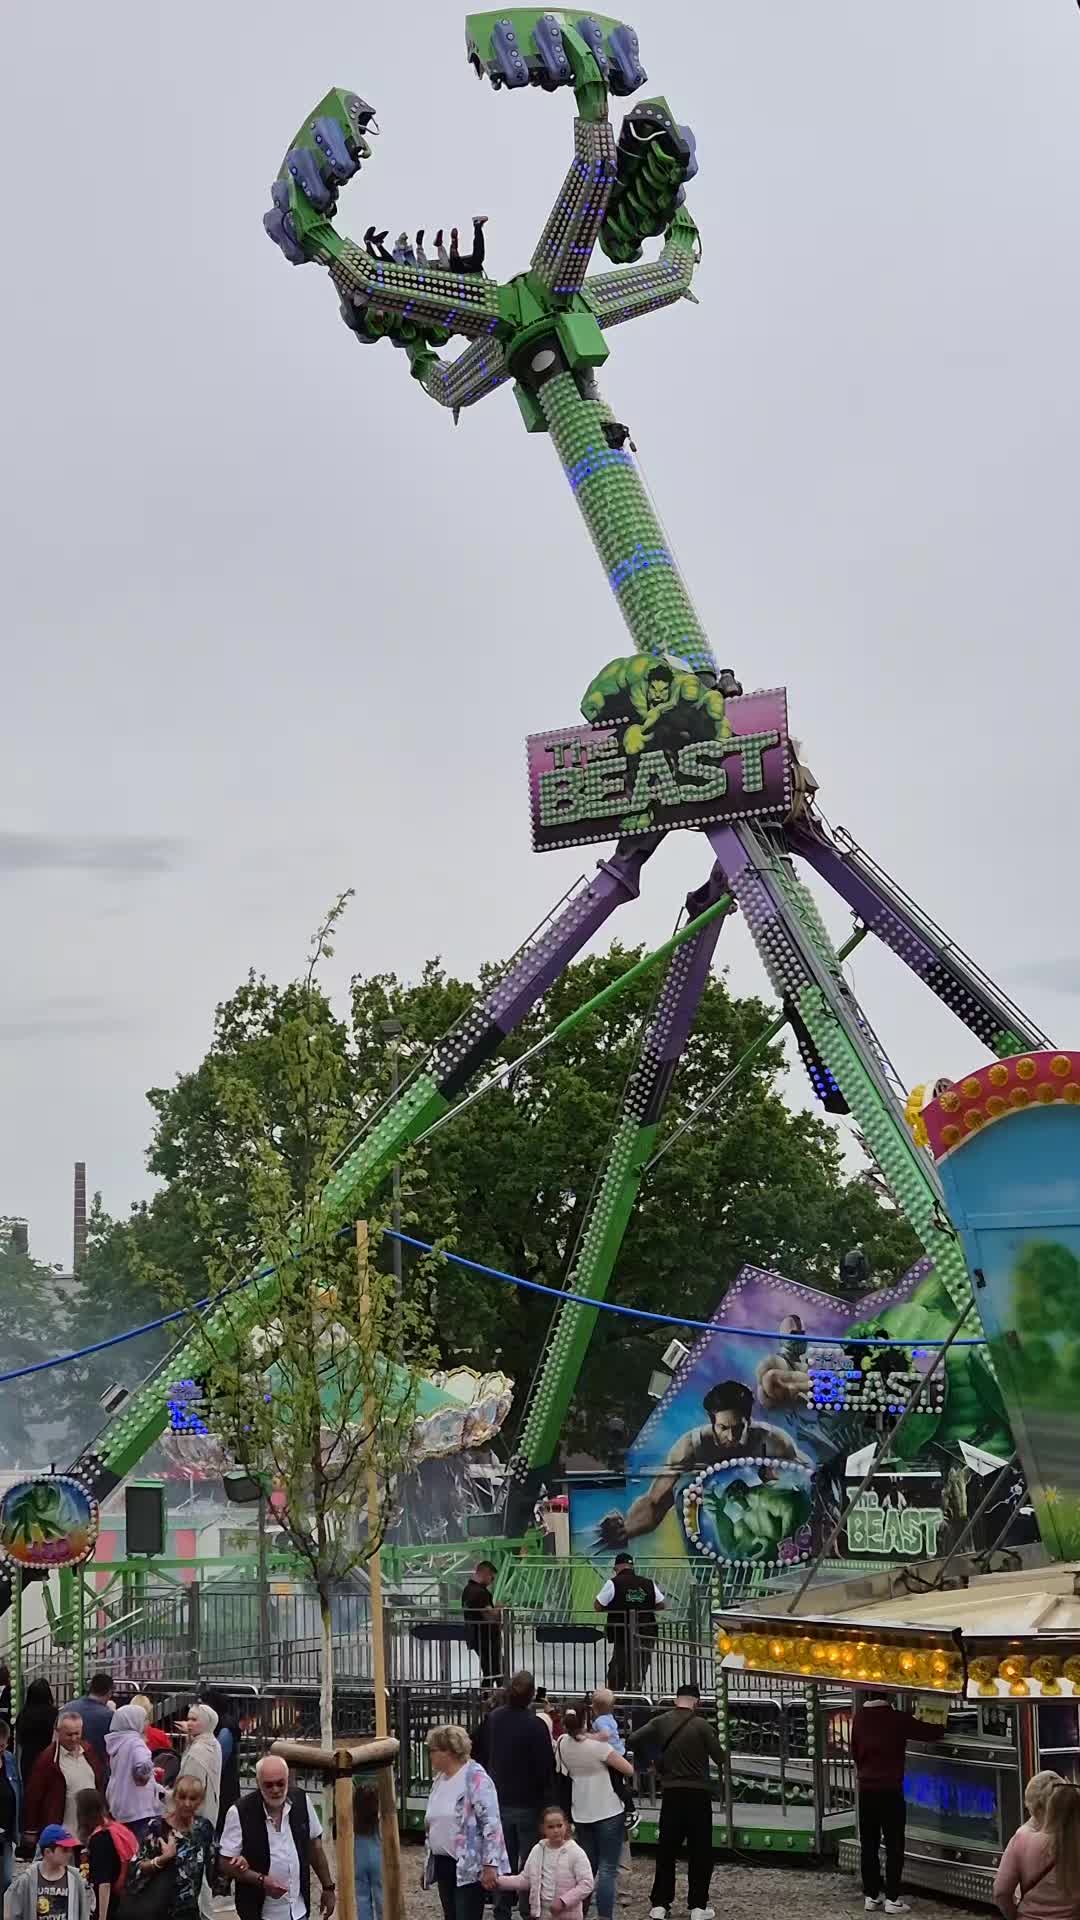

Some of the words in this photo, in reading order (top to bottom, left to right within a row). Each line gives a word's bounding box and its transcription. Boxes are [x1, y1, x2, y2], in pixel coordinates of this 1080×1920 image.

[539, 730, 780, 826] BEAST
[812, 1370, 940, 1406] BEAST
[847, 1508, 944, 1557] BEAST
[37, 1887, 68, 1896] URBAN
